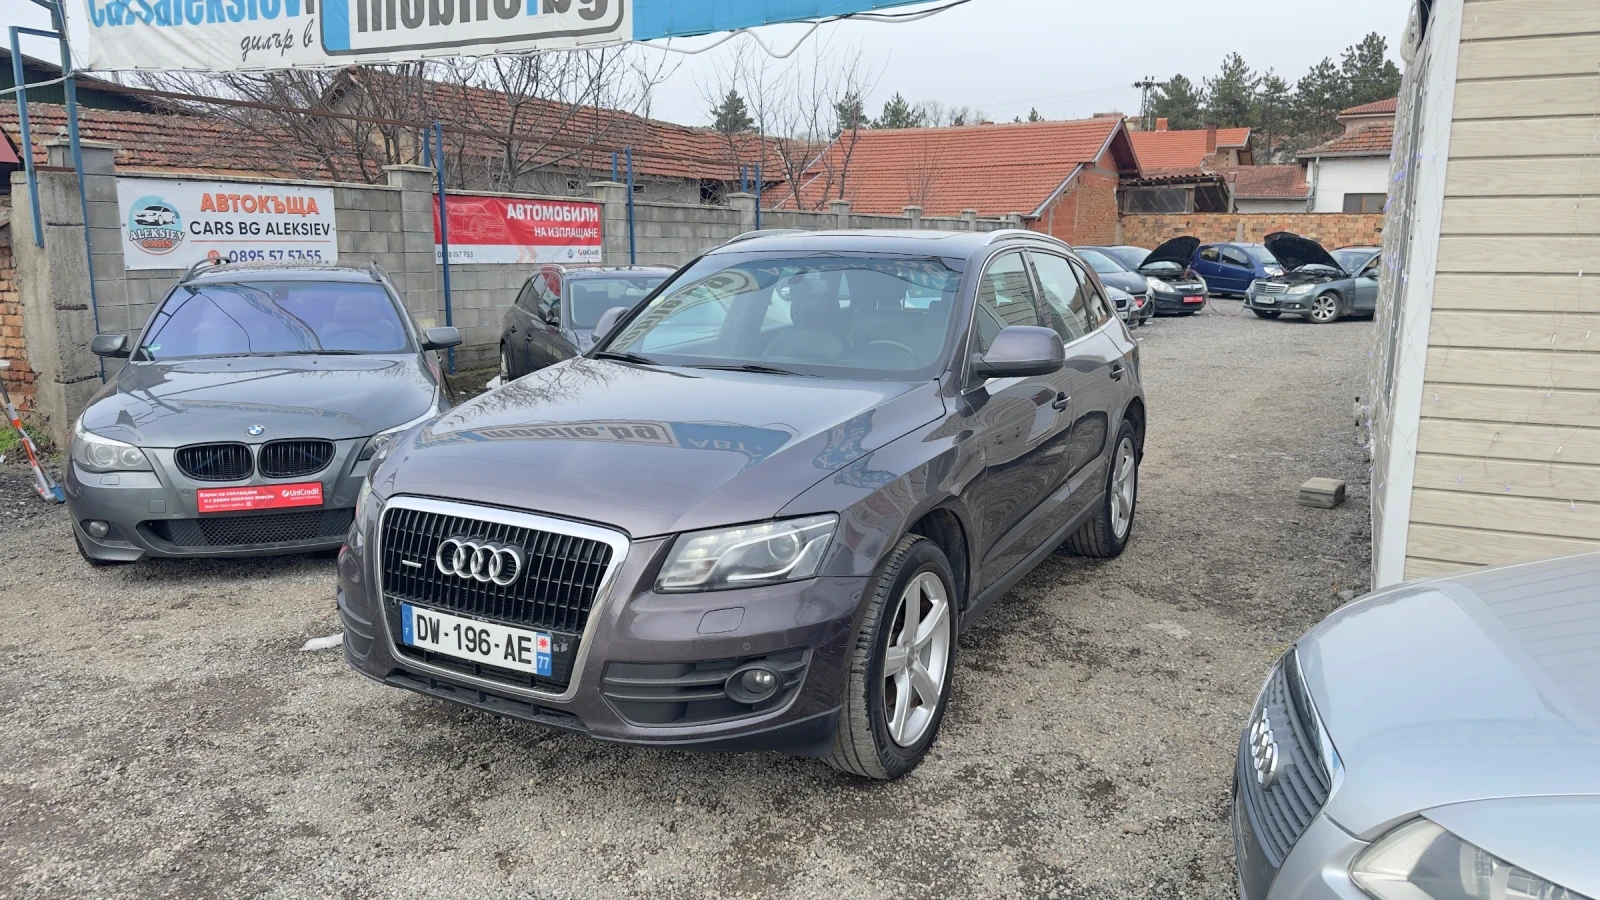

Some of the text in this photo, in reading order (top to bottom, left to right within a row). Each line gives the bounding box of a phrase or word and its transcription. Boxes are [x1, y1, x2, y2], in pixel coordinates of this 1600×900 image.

[240, 18, 314, 62] дилър в
[200, 193, 319, 217] АВТОКЪЩА
[506, 203, 599, 223] АВТОМОБИЛИ
[129, 227, 186, 242] ALEKSIEV
[189, 220, 331, 237] CARS BG ALEKSIEV
[534, 226, 599, 241] НА ИЗПЛАЩАНЕ
[142, 239, 173, 249] CARS
[228, 249, 265, 263] 0895
[269, 249, 284, 261] 57
[306, 249, 322, 261] 55
[289, 488, 320, 496] UniCredit
[405, 627, 410, 635] F
[416, 613, 532, 665] DW-196-AE
[537, 655, 550, 669] 77
